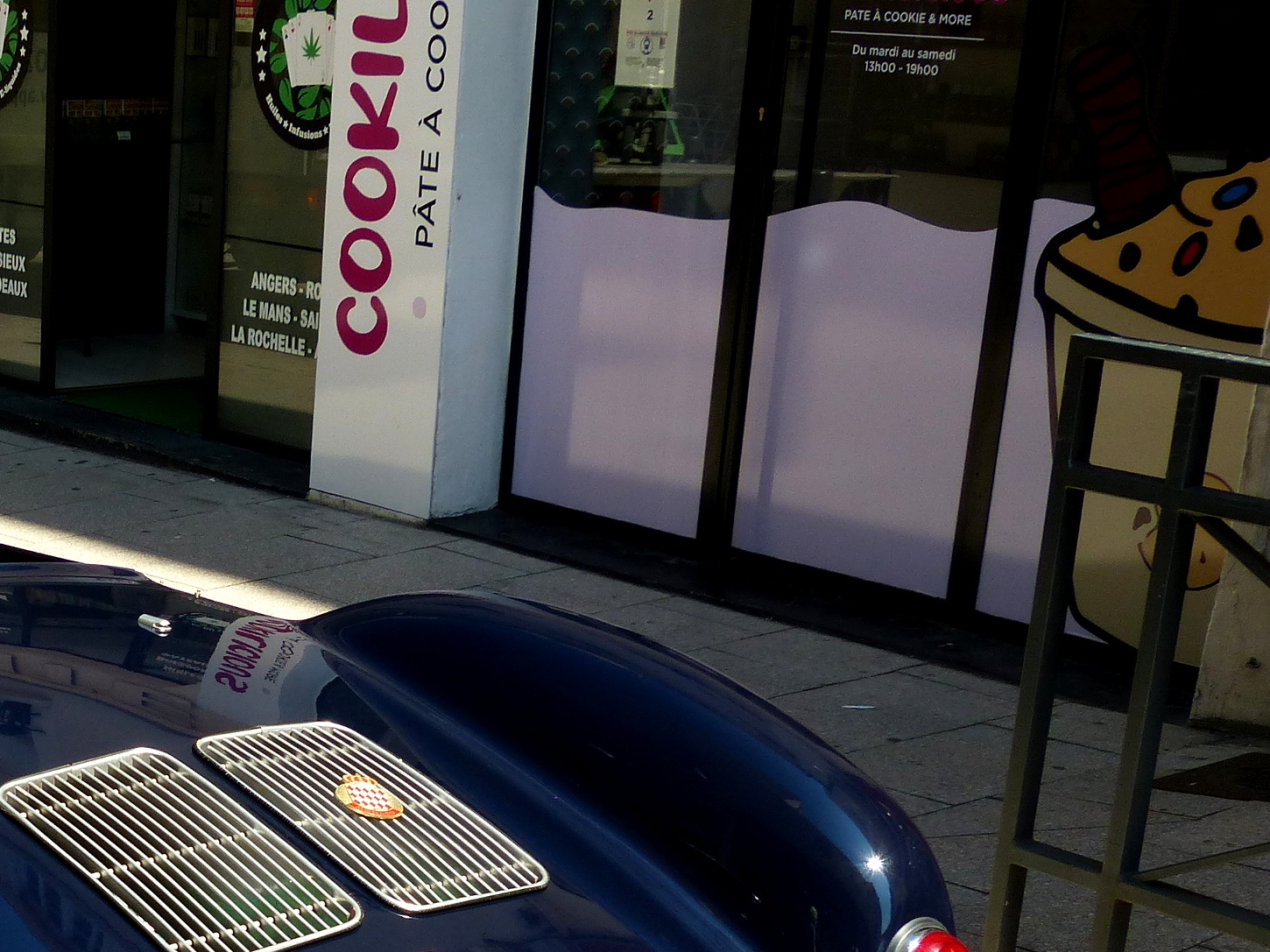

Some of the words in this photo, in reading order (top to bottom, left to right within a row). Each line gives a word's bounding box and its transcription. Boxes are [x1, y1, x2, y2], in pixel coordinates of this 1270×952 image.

[646, 9, 654, 21] 2
[844, 9, 871, 22] PATE
[873, 8, 881, 22] À
[884, 11, 926, 24] COOKIE
[928, 13, 936, 24] &
[938, 14, 972, 26] MORE
[425, 0, 450, 93] COO
[852, 44, 867, 56] Du
[869, 46, 899, 58] mardi
[901, 49, 915, 59] au
[917, 49, 956, 61] samedi
[864, 61, 896, 73] 13h00
[906, 63, 939, 76] 19h00
[265, 92, 284, 125] Huiles
[288, 122, 323, 139] Infusions
[418, 108, 443, 136] À
[336, 0, 408, 355] COOKIL
[412, 149, 441, 248] PÂTE
[250, 271, 297, 296] ANGERS
[306, 281, 322, 300] RO
[242, 298, 257, 318] LE
[259, 301, 291, 325] MANS
[231, 324, 246, 344] LA
[247, 327, 306, 357] ROCHELLE
